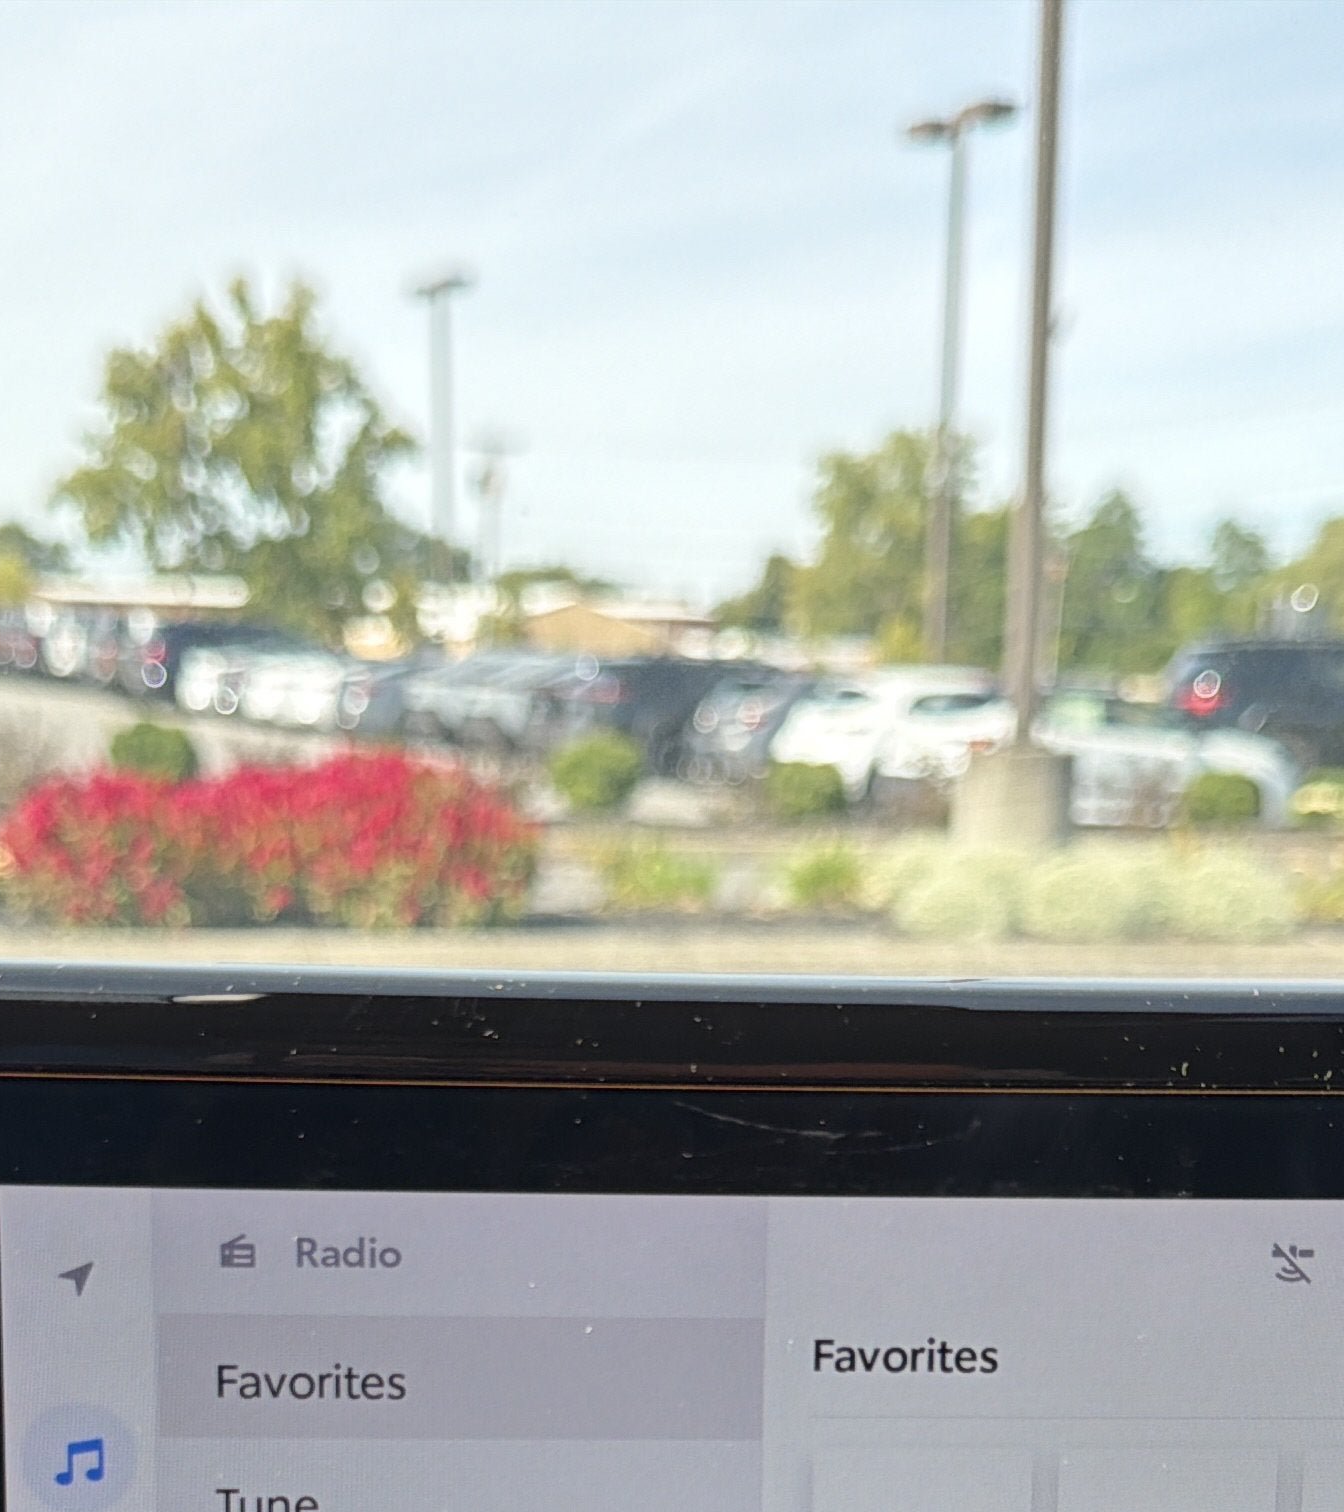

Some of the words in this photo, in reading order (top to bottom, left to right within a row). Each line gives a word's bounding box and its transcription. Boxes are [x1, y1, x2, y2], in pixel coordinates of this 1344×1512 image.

[296, 1235, 403, 1270] Radio
[812, 1337, 999, 1375] Favorites
[216, 1362, 407, 1401] Favorites
